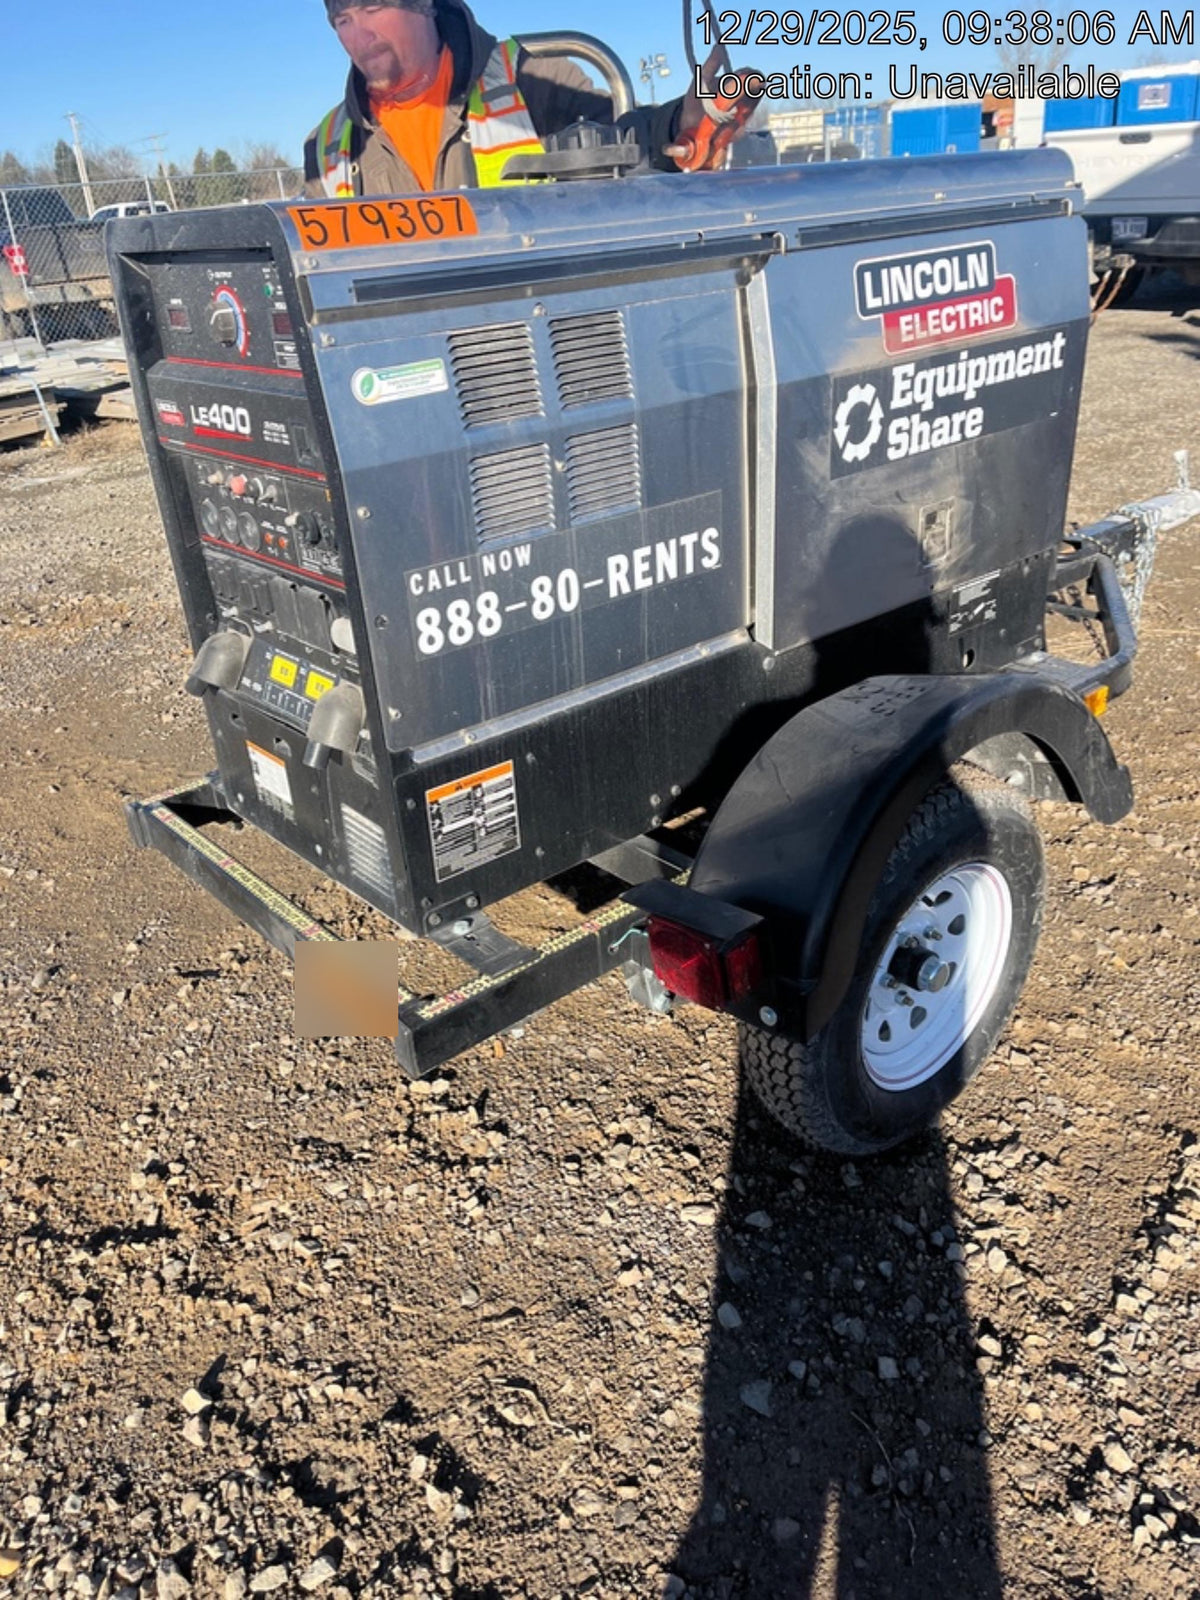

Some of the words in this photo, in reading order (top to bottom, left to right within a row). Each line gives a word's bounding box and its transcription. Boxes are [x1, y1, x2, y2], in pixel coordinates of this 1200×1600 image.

[299, 196, 467, 246] 579367
[863, 252, 990, 309] LINCOLN
[899, 295, 1005, 343] ELECTRIC
[889, 331, 1067, 411] Equipment
[190, 403, 251, 435] LE400
[886, 405, 985, 462] Share
[409, 561, 472, 596] CALL
[481, 543, 533, 577] NOW
[416, 527, 722, 655] 888-80-RENTS
